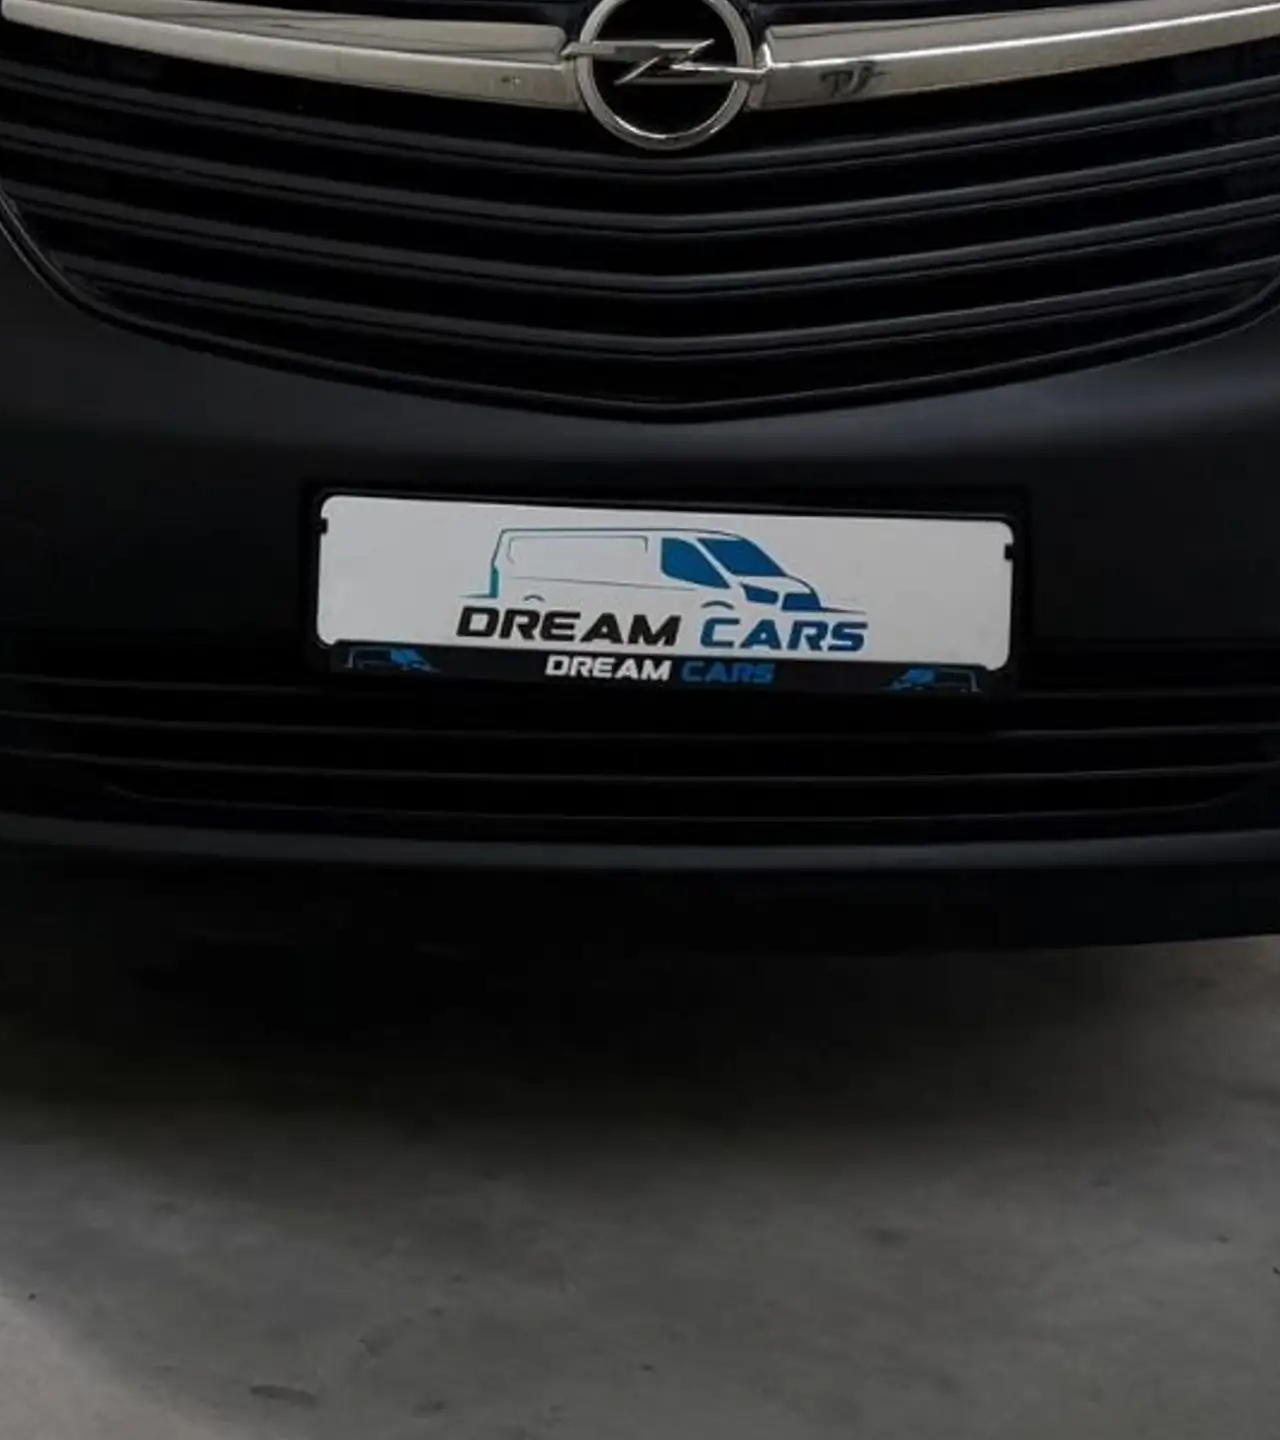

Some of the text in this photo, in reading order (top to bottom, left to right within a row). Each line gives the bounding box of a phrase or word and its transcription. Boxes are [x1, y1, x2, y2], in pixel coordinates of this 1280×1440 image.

[456, 605, 869, 653] DREAM CARS
[544, 653, 777, 684] DREAM CARS
